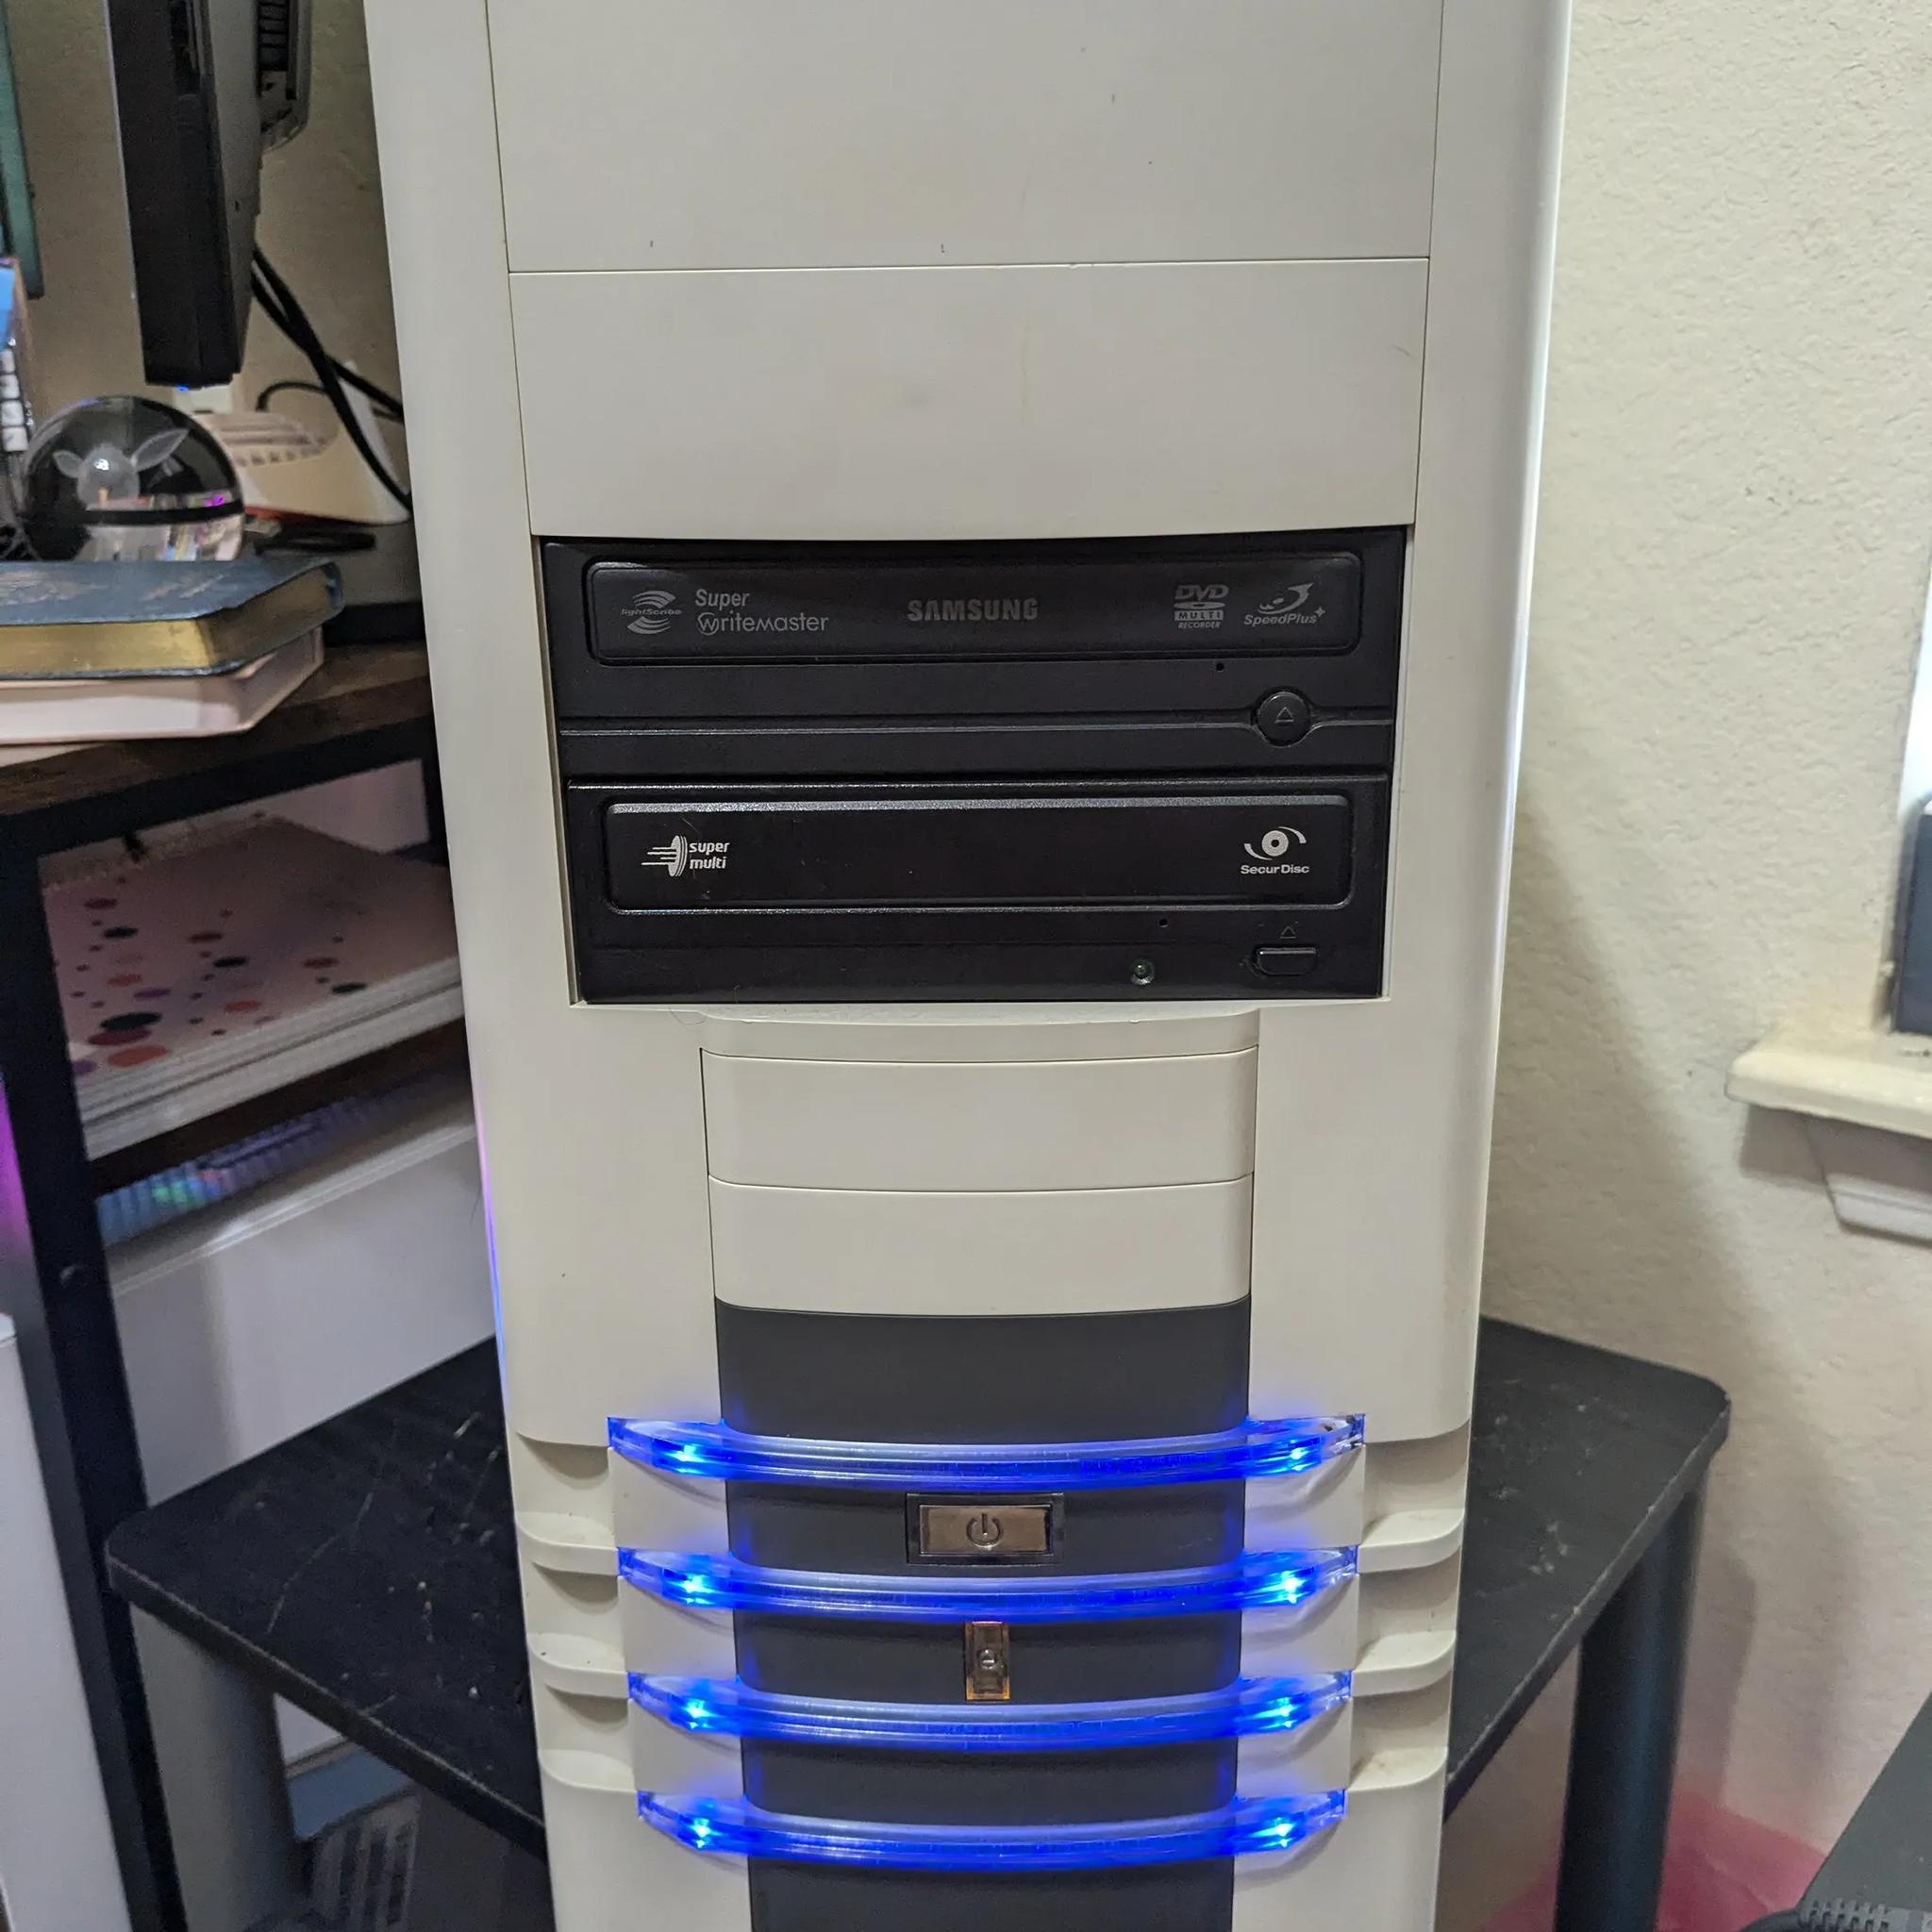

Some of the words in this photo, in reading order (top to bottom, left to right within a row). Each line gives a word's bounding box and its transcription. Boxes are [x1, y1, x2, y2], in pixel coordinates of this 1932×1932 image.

[695, 589, 750, 610] Super
[1174, 585, 1229, 601] DVD
[907, 598, 1038, 622] SAMSUNG
[689, 842, 730, 855] super
[689, 856, 727, 870] multi
[1241, 864, 1309, 874] SecurDisc
